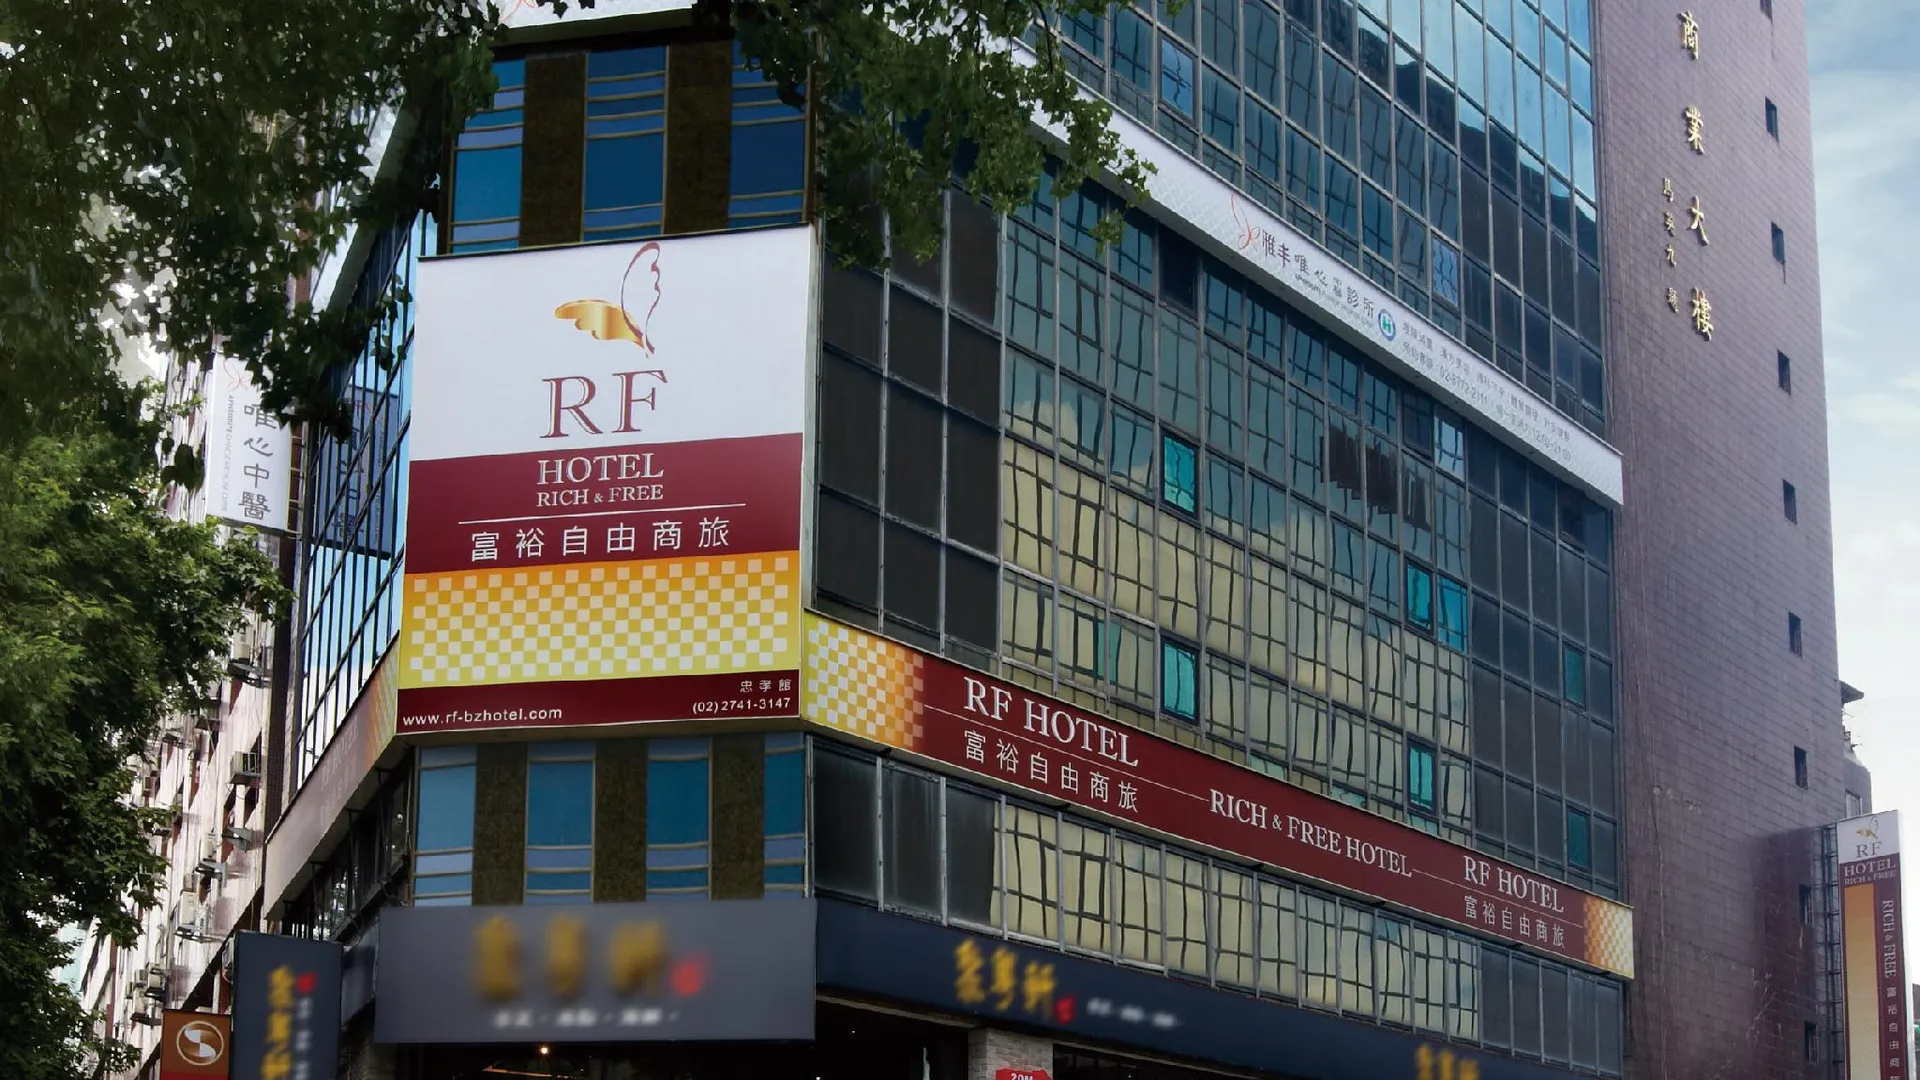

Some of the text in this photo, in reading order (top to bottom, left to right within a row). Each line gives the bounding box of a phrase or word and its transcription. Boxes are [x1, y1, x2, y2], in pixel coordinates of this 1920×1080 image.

[1677, 10, 1713, 341] 商業大樓
[540, 369, 668, 439] RF
[537, 452, 664, 485] HOTEL
[537, 484, 664, 507] RICH & FREE
[471, 516, 731, 562] 富裕自由商旅
[740, 678, 792, 694] 忠孝館
[403, 706, 562, 727] www.rf-bzhotel.com
[692, 697, 791, 715] (02)2741-3147
[963, 676, 1139, 767] RF HOTEL
[964, 729, 1139, 814] 富裕自由商旅
[1210, 789, 1412, 878] RICH & FREE HOTEL
[1856, 841, 1882, 858] RF
[1463, 855, 1564, 914] RF HOTEL
[1844, 858, 1896, 877] HOTEL
[1844, 875, 1866, 885] RICH
[1873, 870, 1896, 881] FREE
[1464, 895, 1565, 949] 富裕自由商旅
[1882, 899, 1895, 932] RICH
[1884, 944, 1897, 979] FREE
